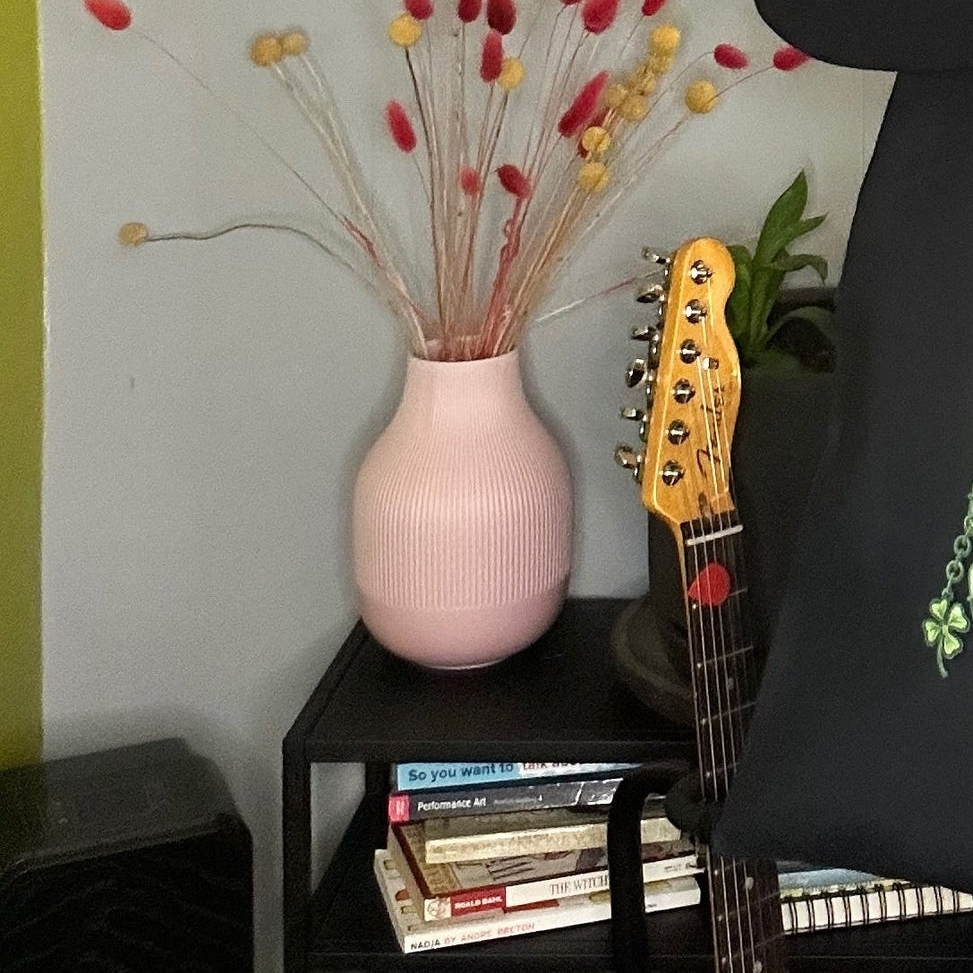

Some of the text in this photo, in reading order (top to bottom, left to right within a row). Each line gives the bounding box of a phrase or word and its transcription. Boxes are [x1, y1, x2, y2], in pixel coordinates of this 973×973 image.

[408, 769, 427, 782] So
[430, 769, 456, 783] you
[461, 763, 496, 777] want
[498, 763, 514, 773] to
[417, 799, 472, 812] Performance
[473, 796, 487, 808] Art
[454, 899, 481, 909] ROALD
[550, 881, 569, 895] THE
[410, 939, 440, 950] NADJA
[444, 937, 456, 945] BY
